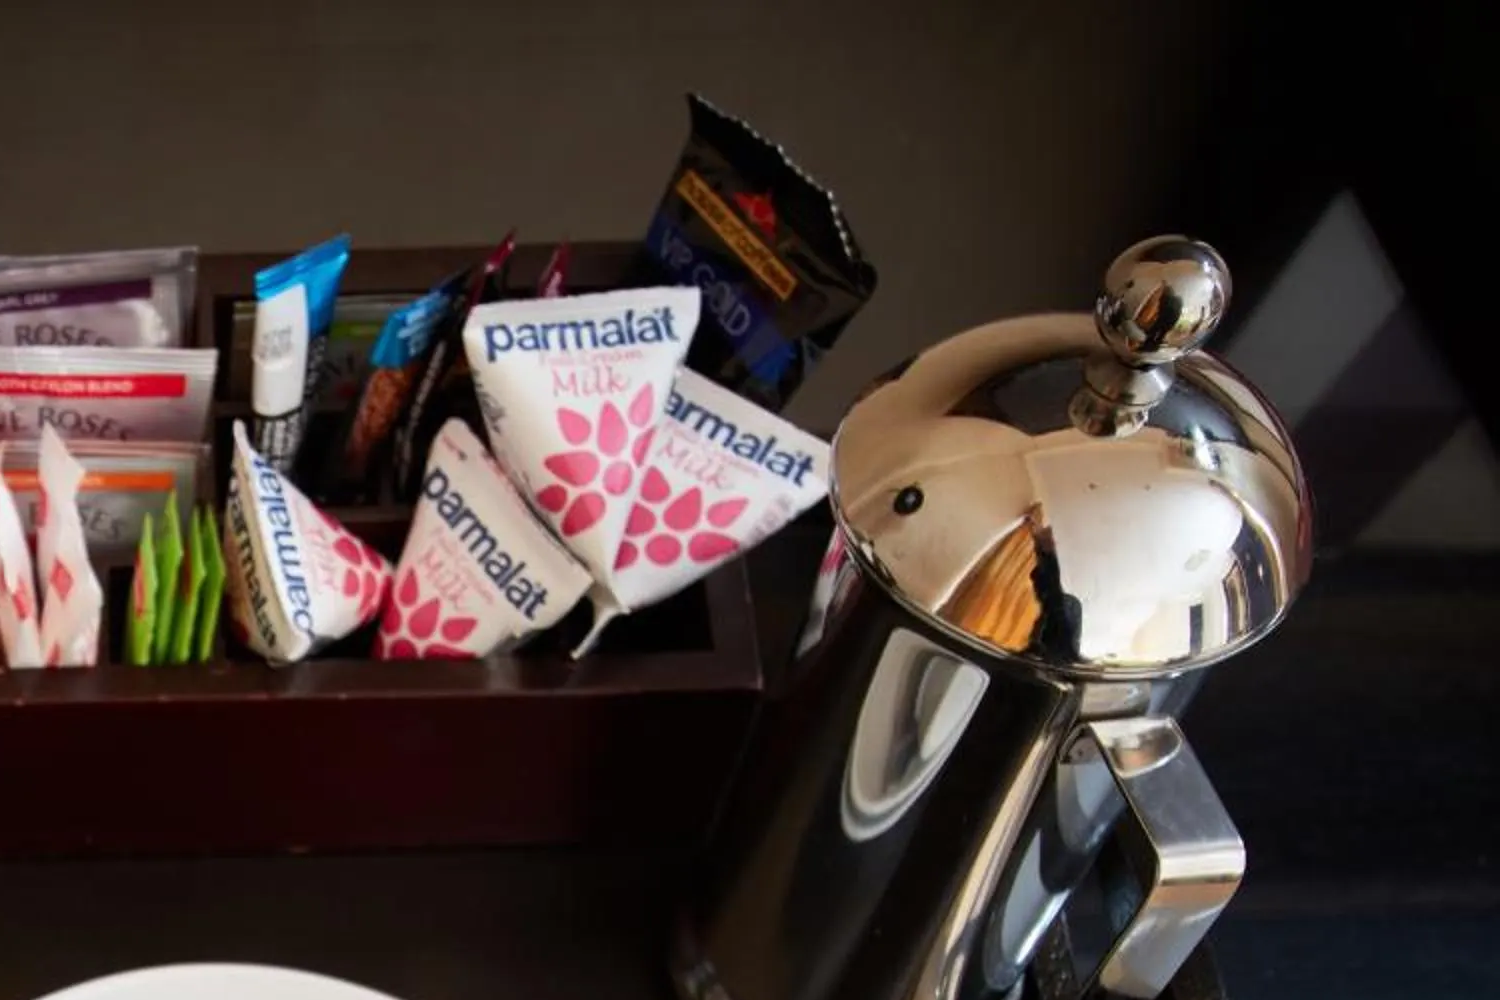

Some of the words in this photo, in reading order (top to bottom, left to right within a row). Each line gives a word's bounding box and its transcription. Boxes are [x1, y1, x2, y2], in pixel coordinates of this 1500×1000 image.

[484, 306, 680, 362] parmalat
[87, 379, 133, 394] BLEND
[552, 364, 630, 398] Milk
[665, 389, 815, 488] armalat
[424, 466, 549, 621] parmalat
